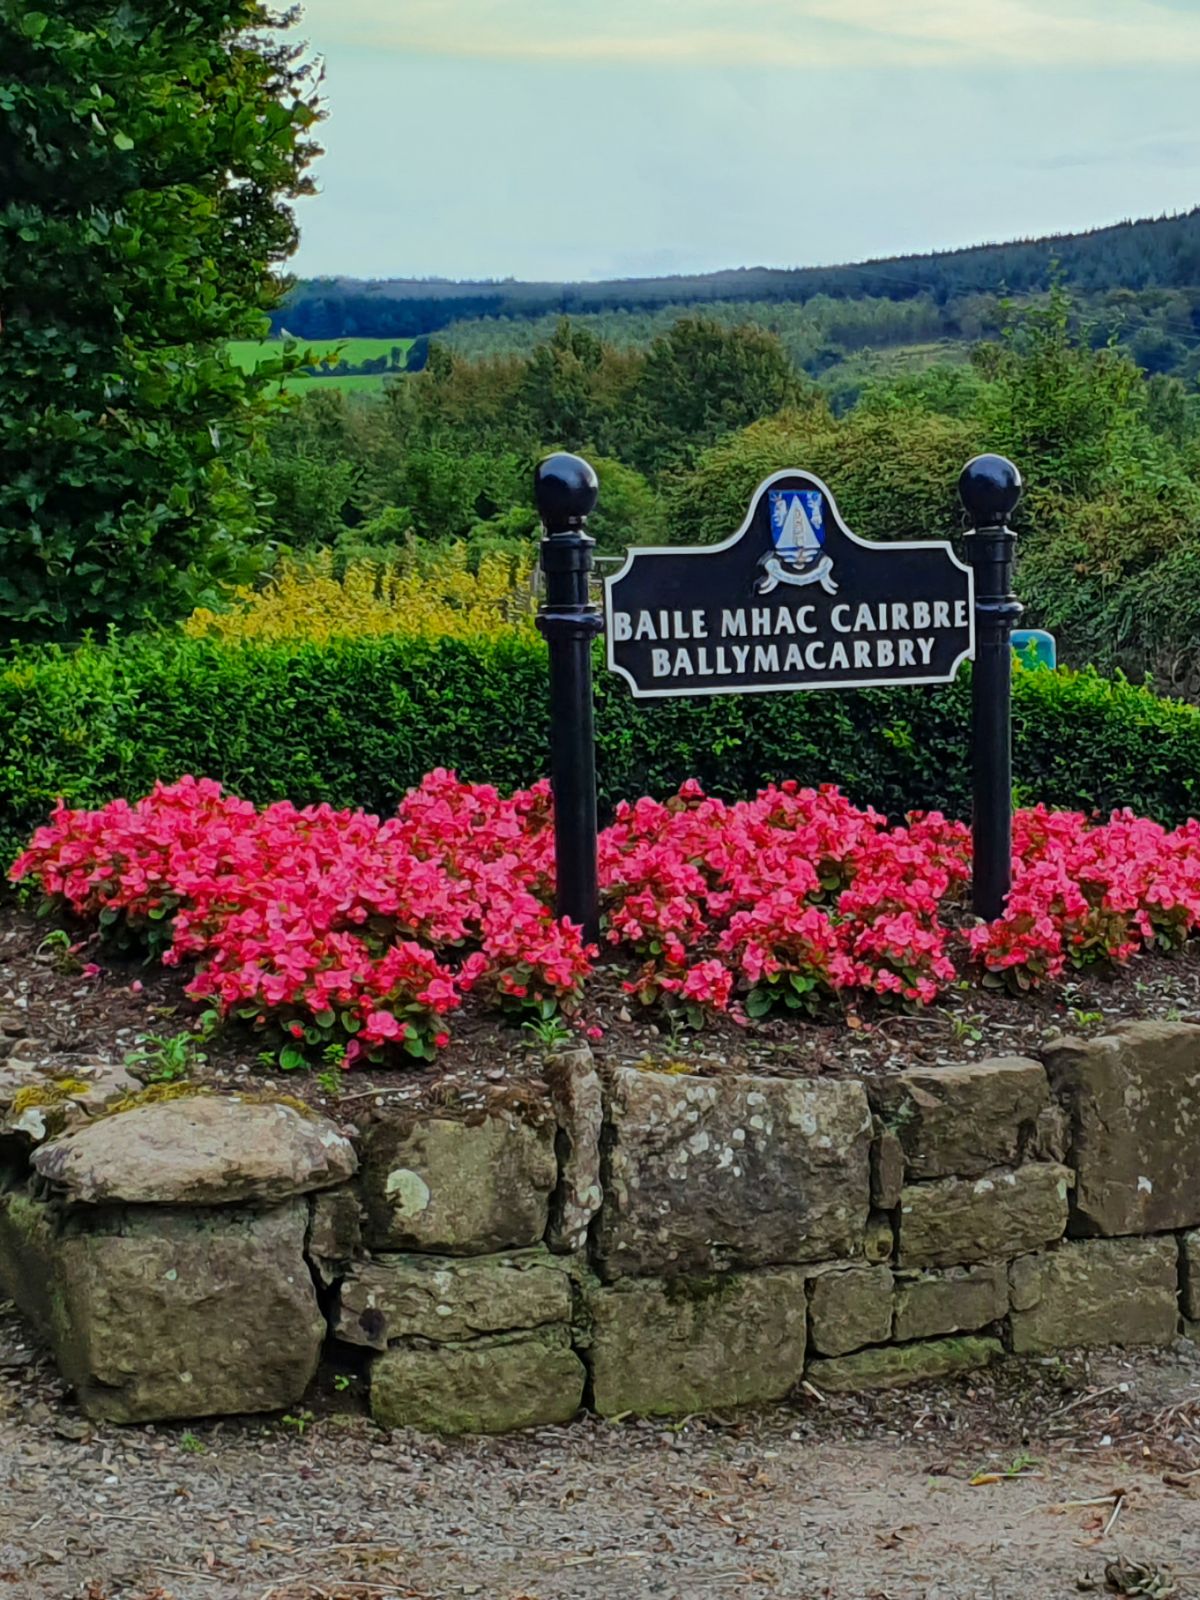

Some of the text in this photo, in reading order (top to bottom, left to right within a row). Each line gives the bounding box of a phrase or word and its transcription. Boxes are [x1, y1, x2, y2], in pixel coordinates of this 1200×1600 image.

[613, 600, 968, 642] BAILE MHAC CAIRBRE
[651, 637, 935, 678] BALLYMACARBRY
